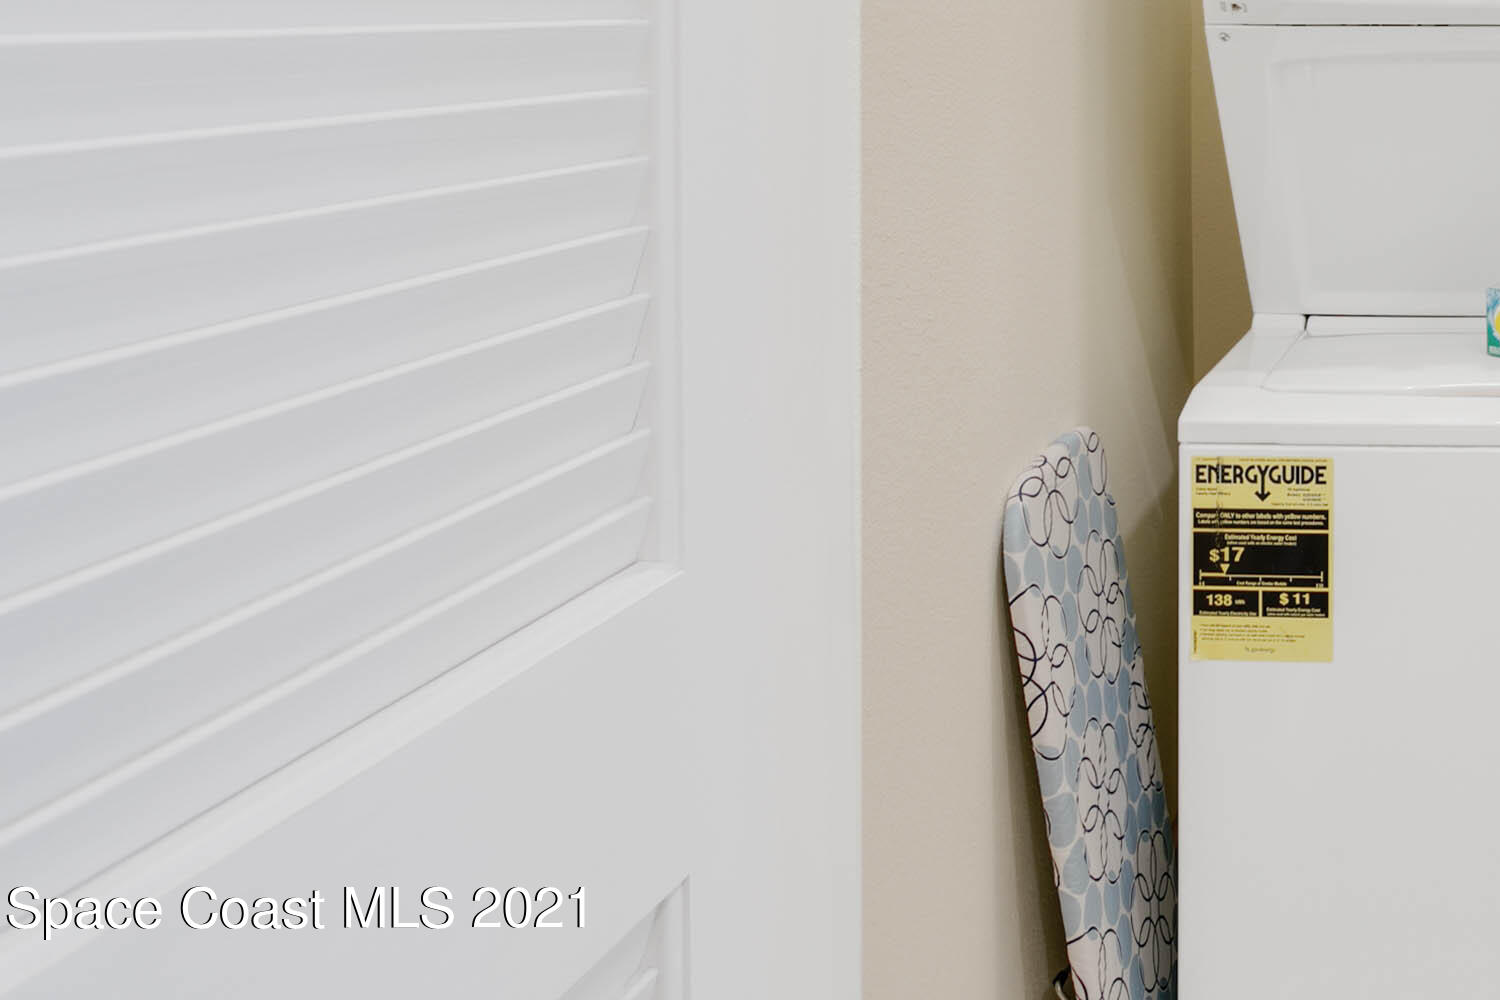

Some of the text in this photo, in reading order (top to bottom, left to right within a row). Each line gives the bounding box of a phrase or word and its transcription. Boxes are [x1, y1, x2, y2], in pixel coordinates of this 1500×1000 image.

[1196, 464, 1327, 485] ENERGYGUIDE
[1196, 512, 1218, 520] Compar
[1209, 547, 1245, 562] $17
[1206, 594, 1233, 606] 138
